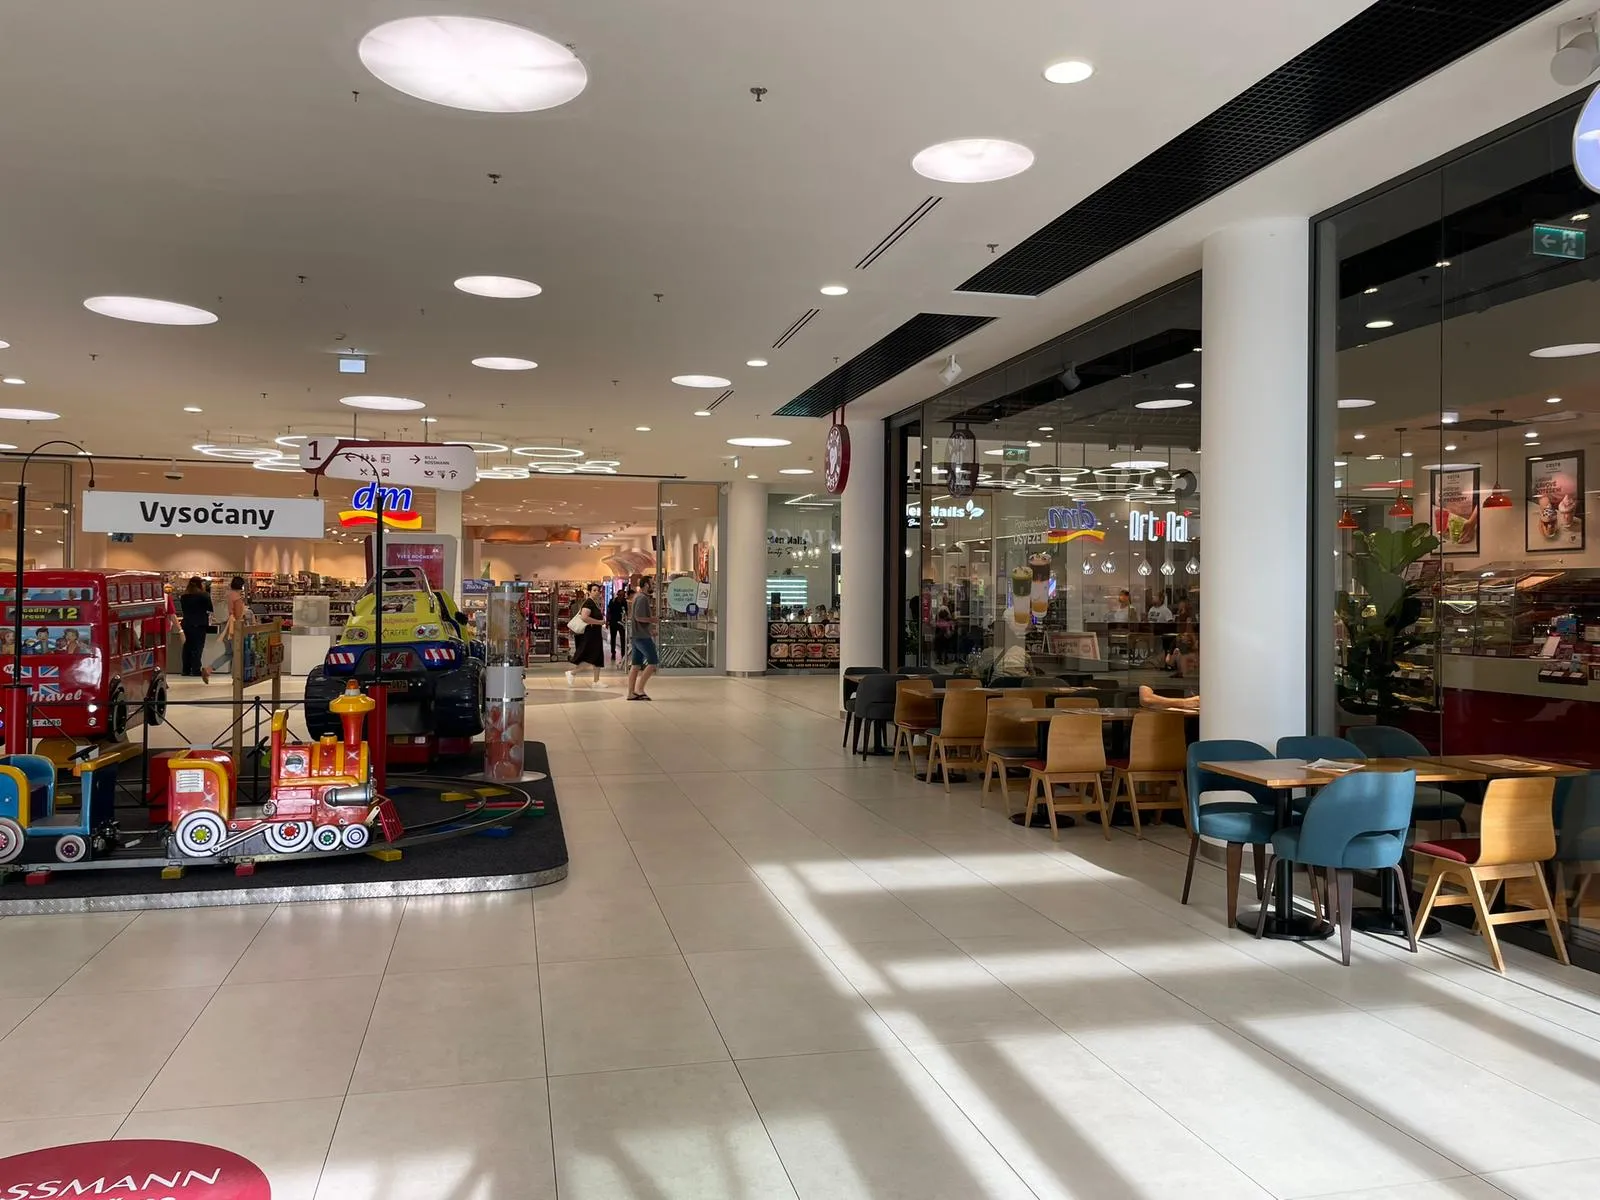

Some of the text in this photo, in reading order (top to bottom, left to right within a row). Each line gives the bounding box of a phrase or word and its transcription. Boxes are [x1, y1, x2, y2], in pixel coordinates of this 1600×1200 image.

[308, 440, 322, 461] 1
[352, 480, 413, 511] dm
[139, 500, 275, 530] Vysočany
[930, 505, 965, 517] Nails
[58, 607, 78, 619] 12
[31, 689, 83, 702] Travel
